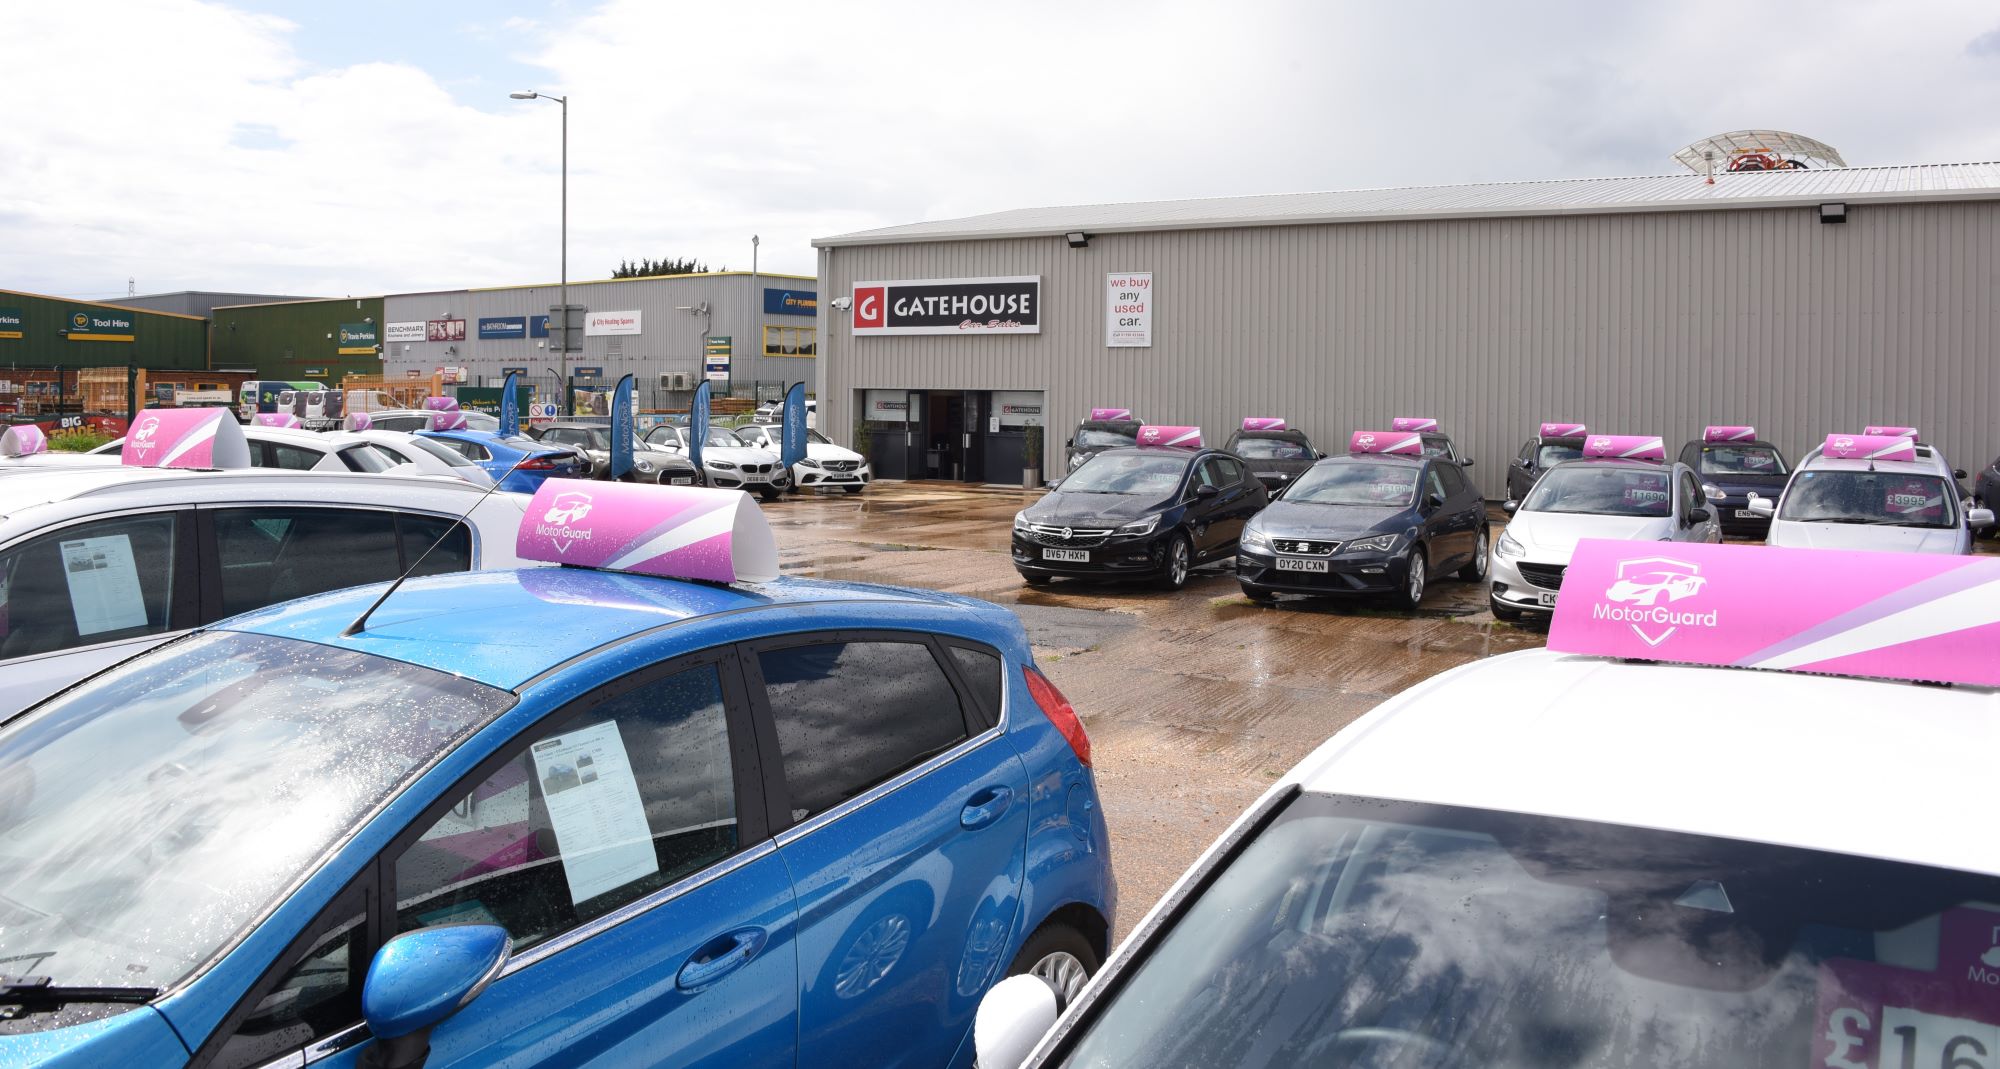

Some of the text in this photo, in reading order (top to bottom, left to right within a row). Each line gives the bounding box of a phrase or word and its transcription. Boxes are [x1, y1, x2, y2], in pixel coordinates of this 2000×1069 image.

[1110, 277, 1150, 289] we buy
[1119, 291, 1140, 302] any
[859, 293, 1031, 321] G GATEHOUSE
[1114, 302, 1144, 313] used
[92, 318, 130, 328] Tool Hire
[958, 318, 1022, 330] Car Sales
[1119, 317, 1142, 326] car.
[387, 325, 424, 333] BENCHMARX
[61, 416, 82, 428] BIG
[48, 423, 96, 439] TRADE
[1887, 494, 1925, 506] £3995
[535, 521, 592, 541] MotorGuard
[1045, 549, 1087, 561] DV67 HXH
[1278, 559, 1325, 571] OY20 CXN
[1542, 592, 1557, 605] CK
[1592, 602, 1718, 627] MotorGuard
